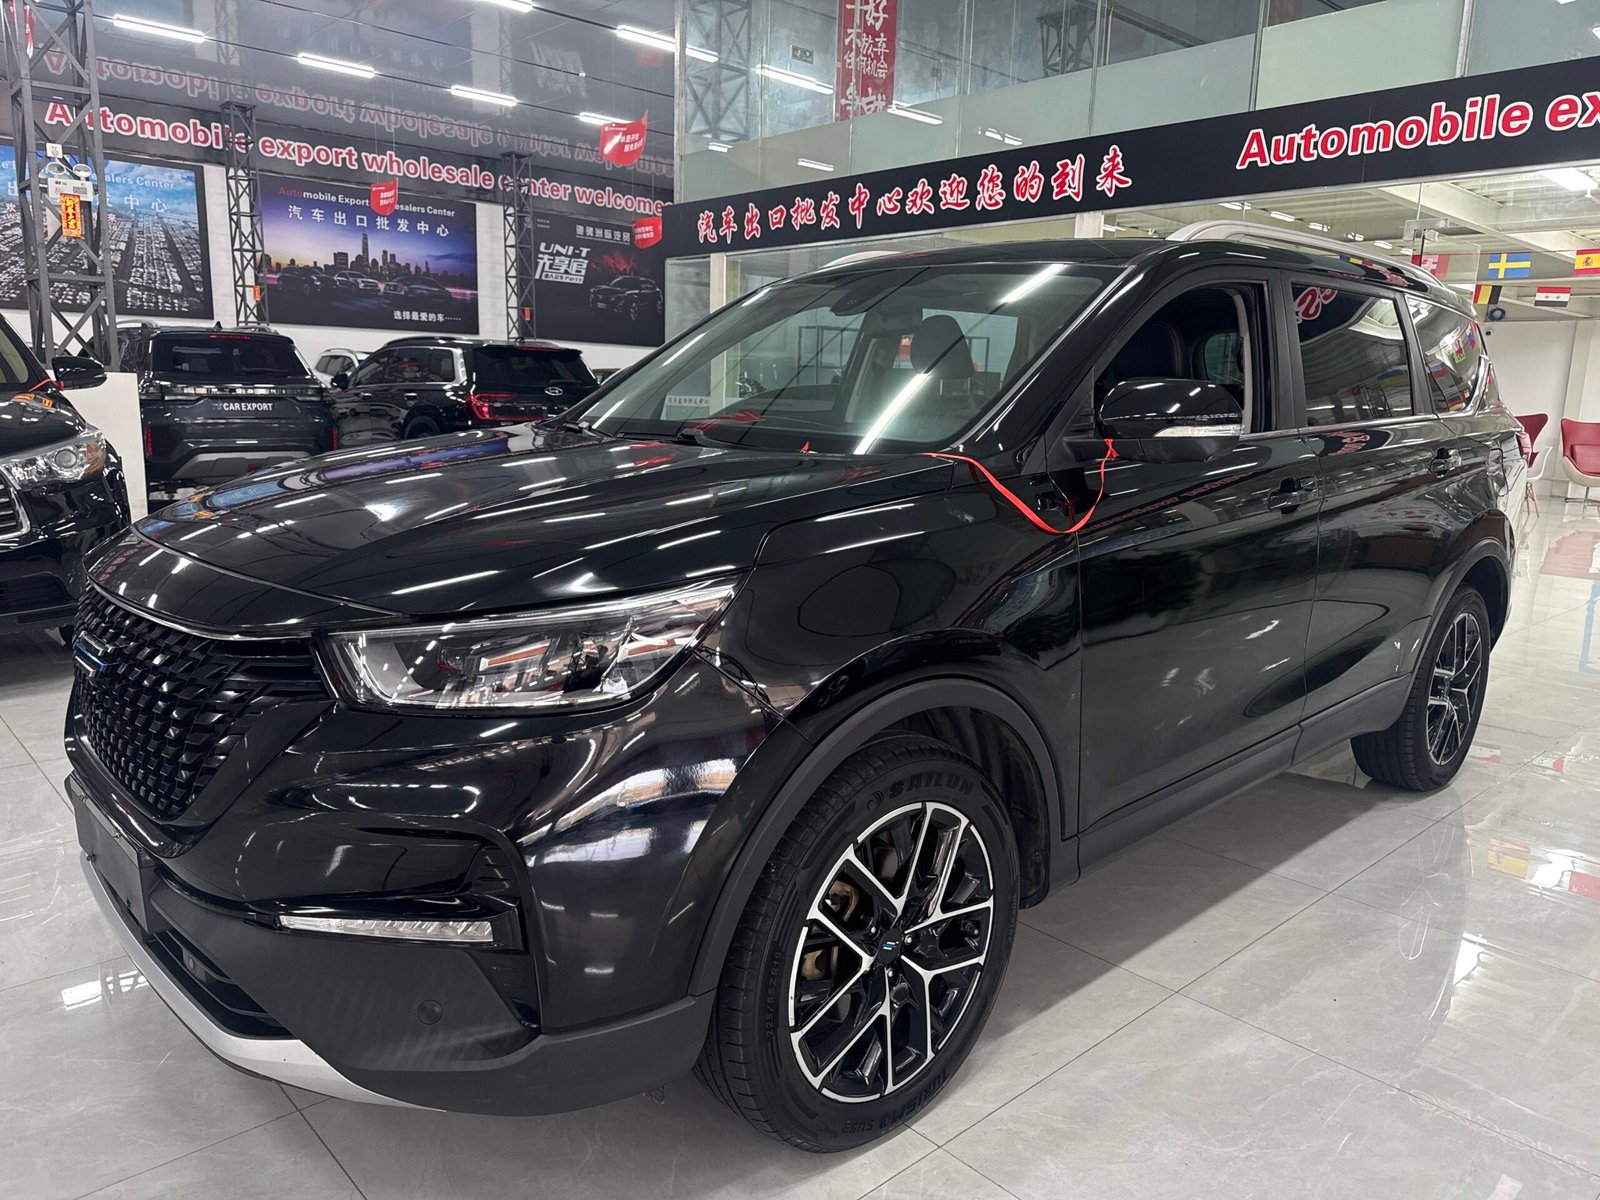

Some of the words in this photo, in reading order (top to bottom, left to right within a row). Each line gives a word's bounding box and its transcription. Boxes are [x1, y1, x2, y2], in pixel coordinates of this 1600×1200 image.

[1236, 94, 1533, 170] Automobile
[136, 176, 175, 189] Center
[259, 136, 358, 168] export
[362, 150, 495, 189] wholesale
[575, 186, 673, 216] welcome
[279, 185, 337, 202] Automobile
[338, 194, 369, 206] Export
[427, 205, 455, 217] Center
[698, 144, 1132, 244] 汽车出口批发中心欢迎您的到来
[288, 204, 449, 237] 汽车出口批发中心
[539, 242, 591, 257] UNI-T
[223, 402, 240, 411] CAR
[241, 402, 273, 411] EXPORT
[889, 772, 975, 799] SAILUN
[766, 951, 781, 1037] 225/55ZR19
